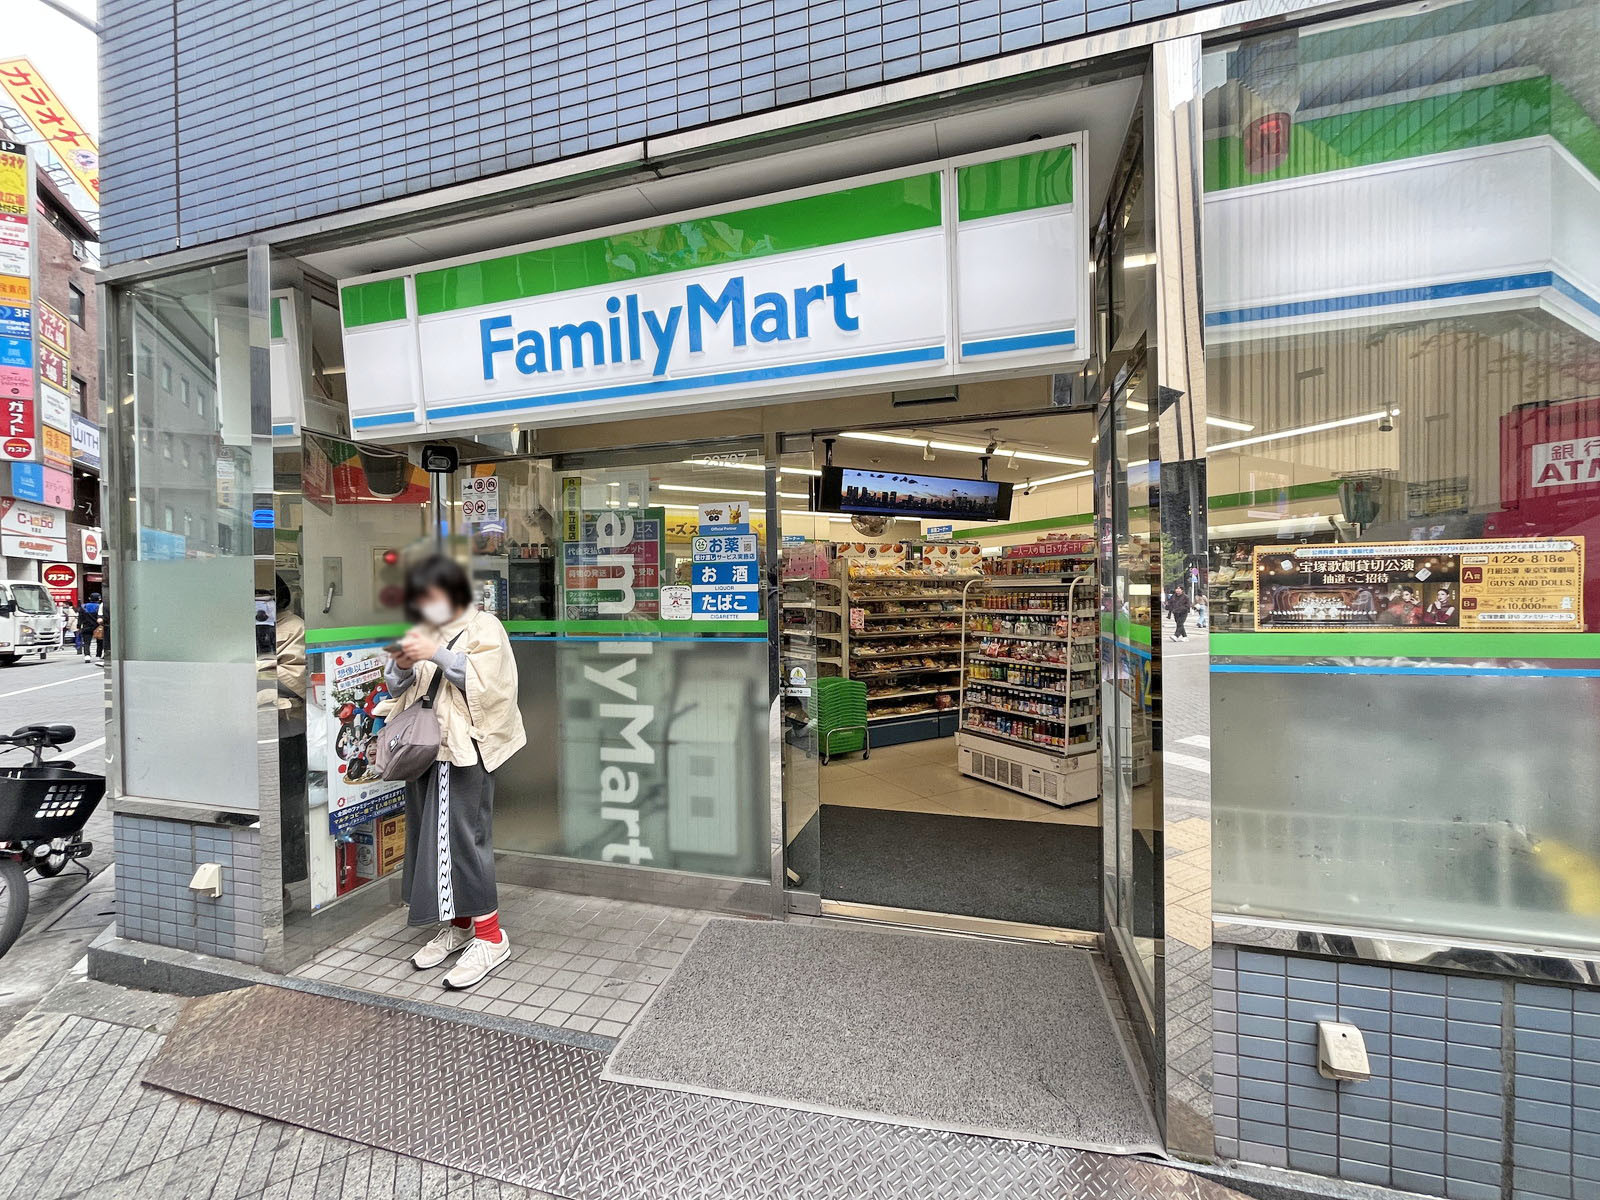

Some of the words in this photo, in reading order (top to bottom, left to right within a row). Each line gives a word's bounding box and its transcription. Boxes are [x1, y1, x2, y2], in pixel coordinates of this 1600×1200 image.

[0, 66, 81, 147] カラオケ
[14, 308, 30, 318] 3F
[480, 263, 860, 380] FamilyMart
[8, 400, 24, 436] ガスト
[72, 426, 99, 451] WITH
[7, 445, 30, 453] ガスト
[709, 537, 739, 553] お薬
[1300, 559, 1415, 574] 宝塚歌劇貸切公演
[48, 574, 73, 582] ガスト
[1323, 573, 1389, 585] 抽選でご招待
[1518, 579, 1539, 587] AND
[702, 594, 748, 610] たばこ
